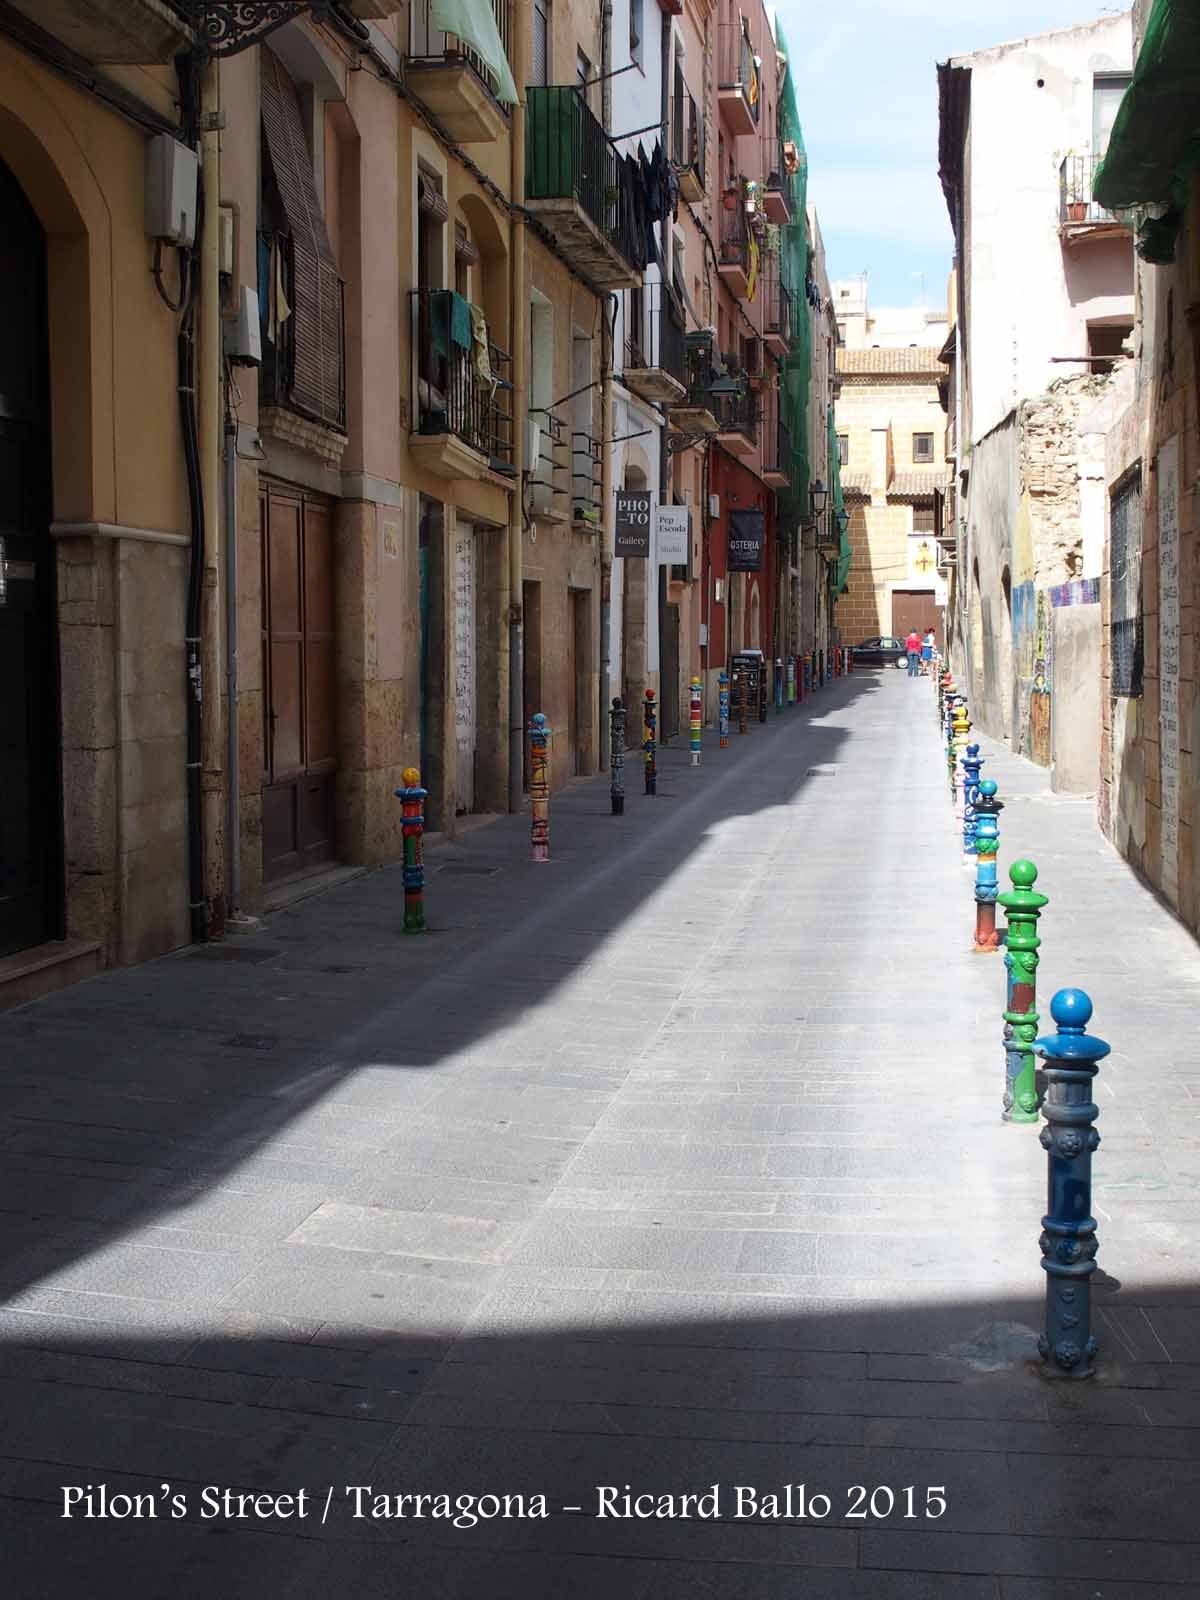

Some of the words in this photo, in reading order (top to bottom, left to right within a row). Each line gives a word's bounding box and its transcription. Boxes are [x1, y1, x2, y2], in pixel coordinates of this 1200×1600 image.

[618, 500, 649, 512] PHO
[618, 536, 645, 546] Gallery
[730, 540, 760, 550] OSTERIA
